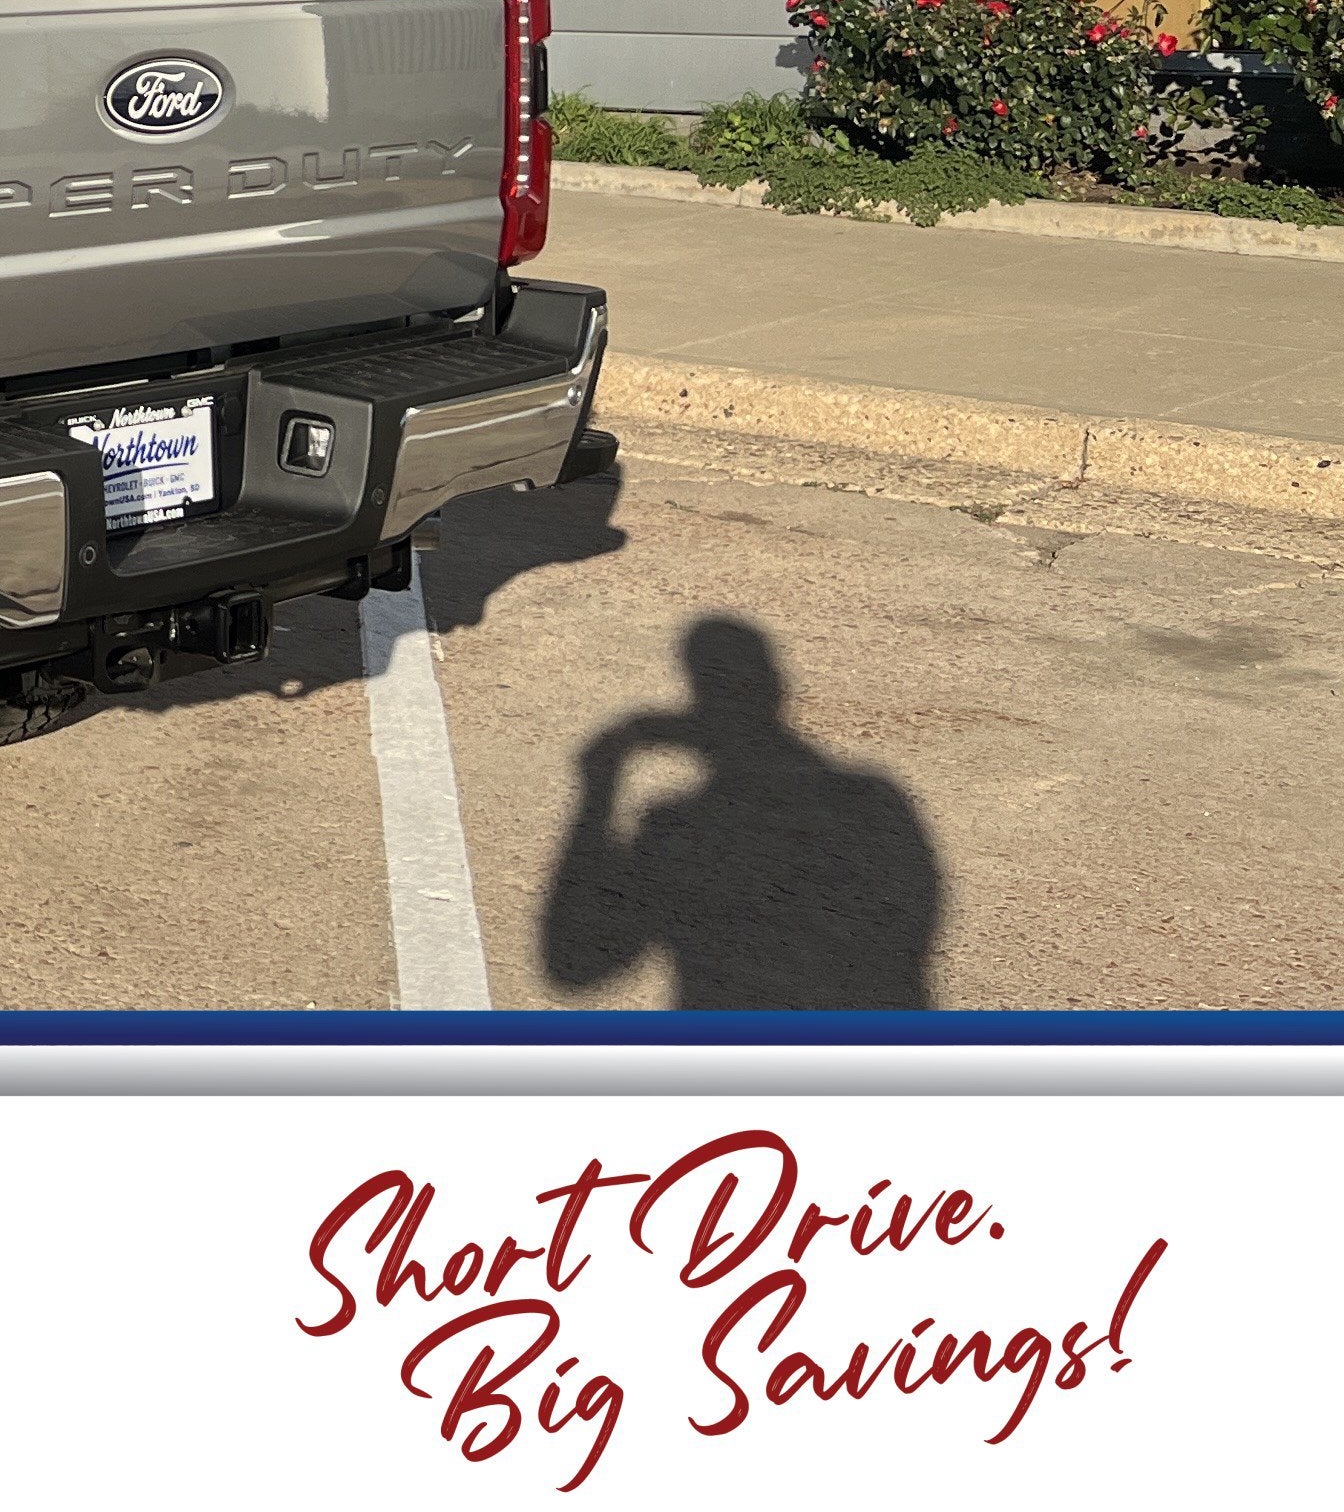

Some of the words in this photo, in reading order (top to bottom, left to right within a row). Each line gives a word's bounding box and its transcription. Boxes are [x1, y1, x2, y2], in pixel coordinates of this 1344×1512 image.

[128, 71, 204, 120] Ford
[228, 136, 475, 200] DUTY
[186, 396, 214, 408] GMC
[67, 415, 97, 426] BUICK
[109, 406, 176, 429] Northtown
